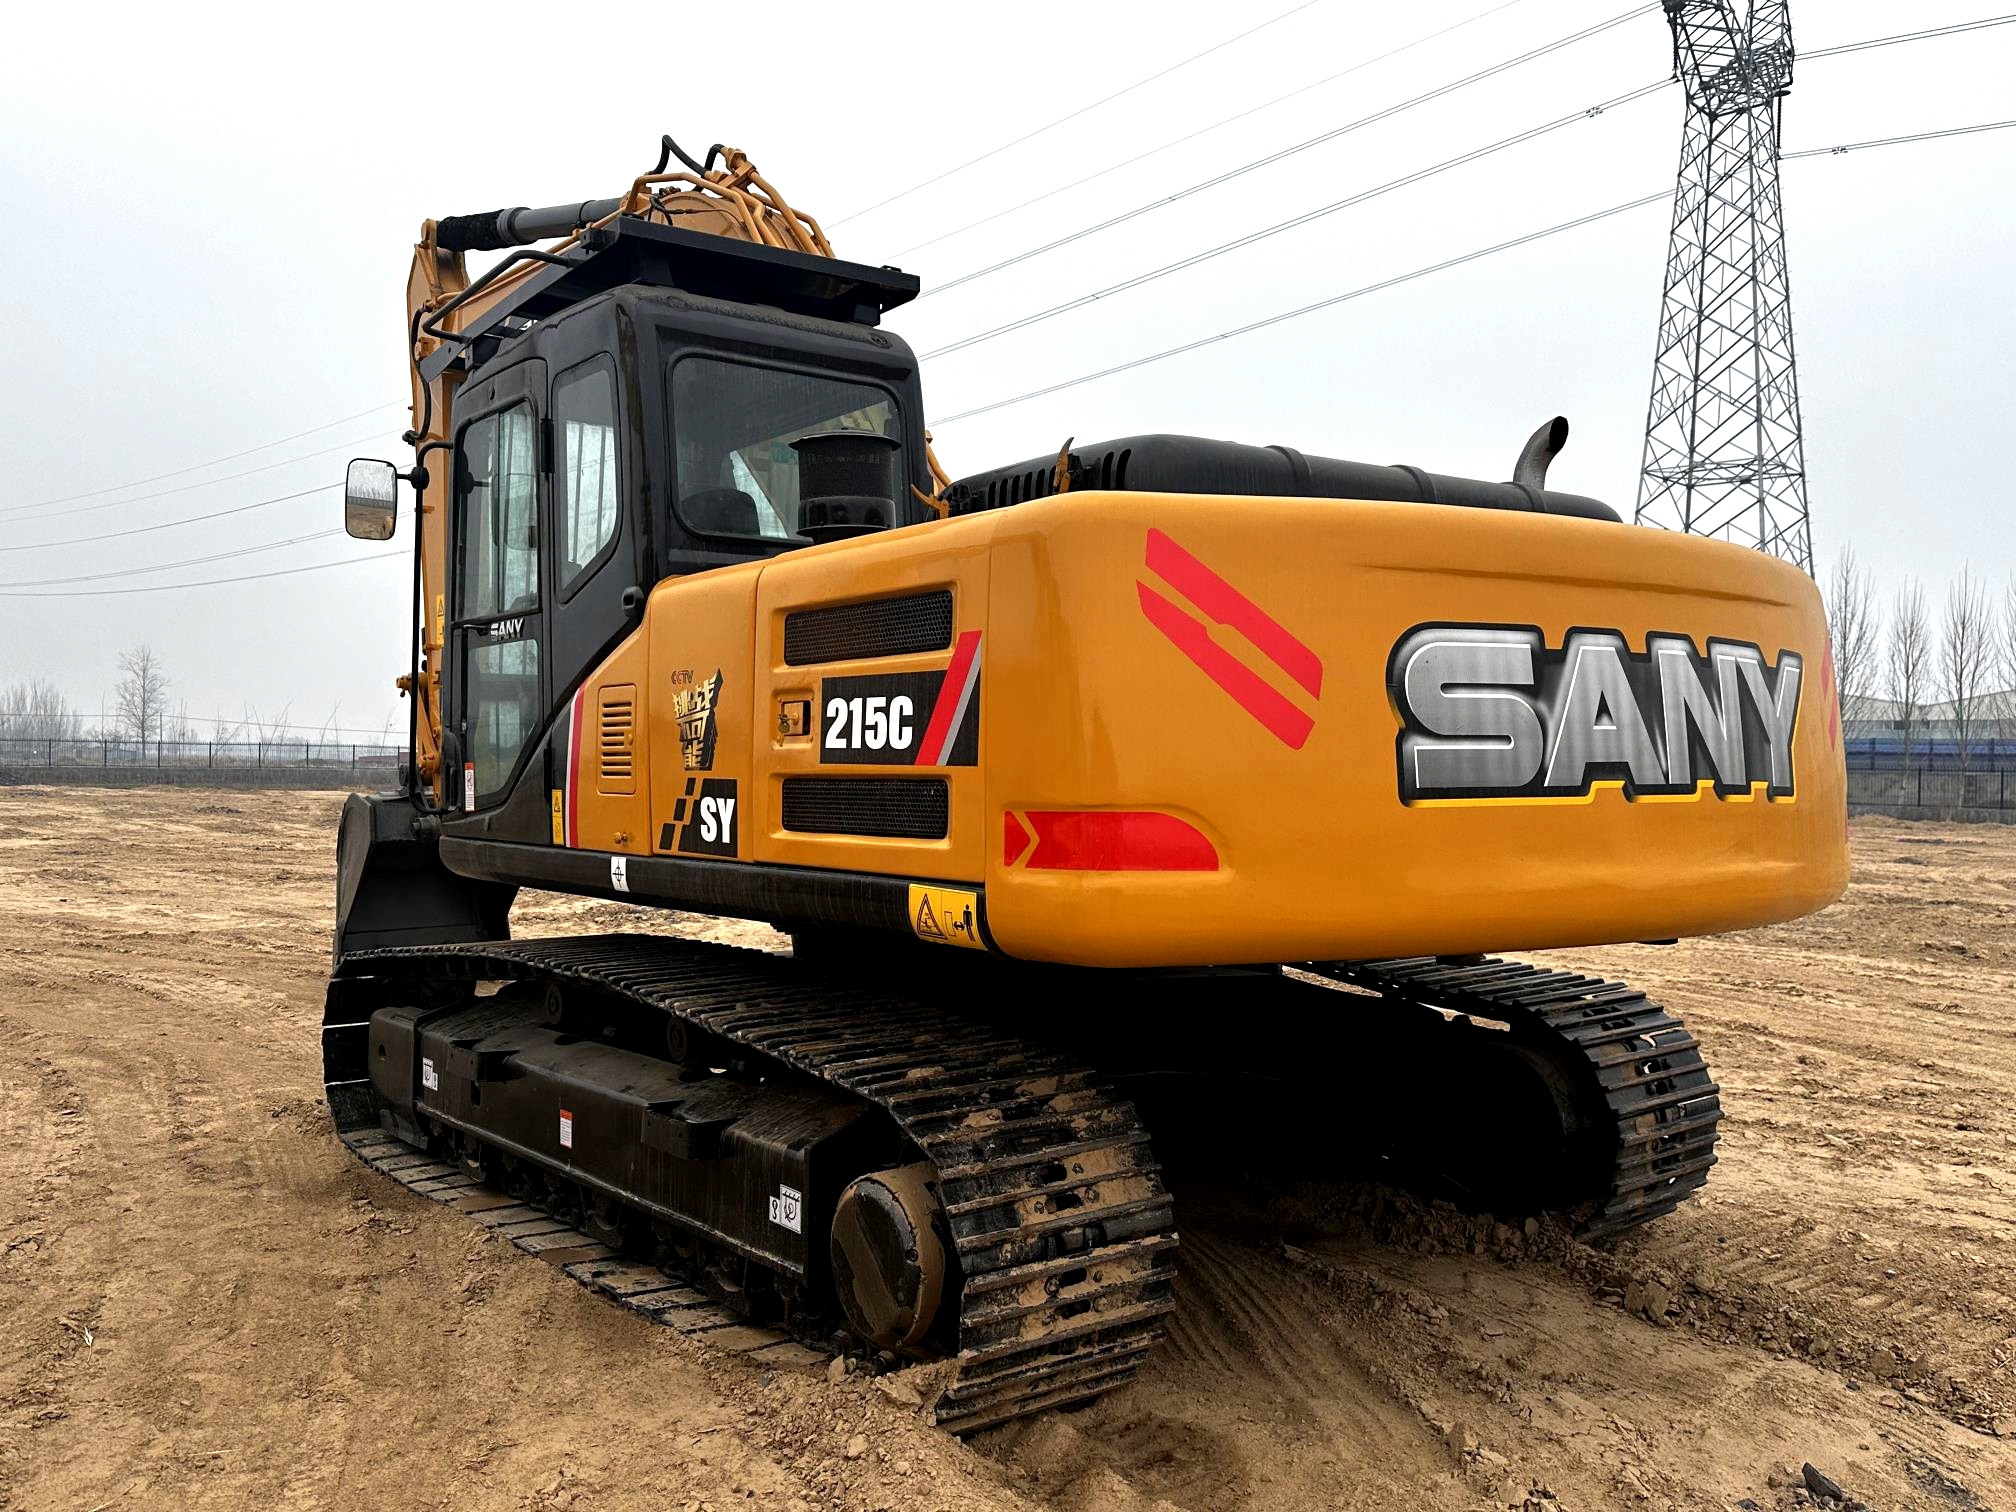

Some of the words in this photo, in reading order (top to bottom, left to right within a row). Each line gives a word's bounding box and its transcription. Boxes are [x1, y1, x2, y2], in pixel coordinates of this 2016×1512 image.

[490, 618, 524, 641] SANY
[671, 670, 694, 684] CCTV
[824, 695, 914, 750] 215C
[1398, 632, 1803, 794] SANY
[700, 796, 735, 844] SY
